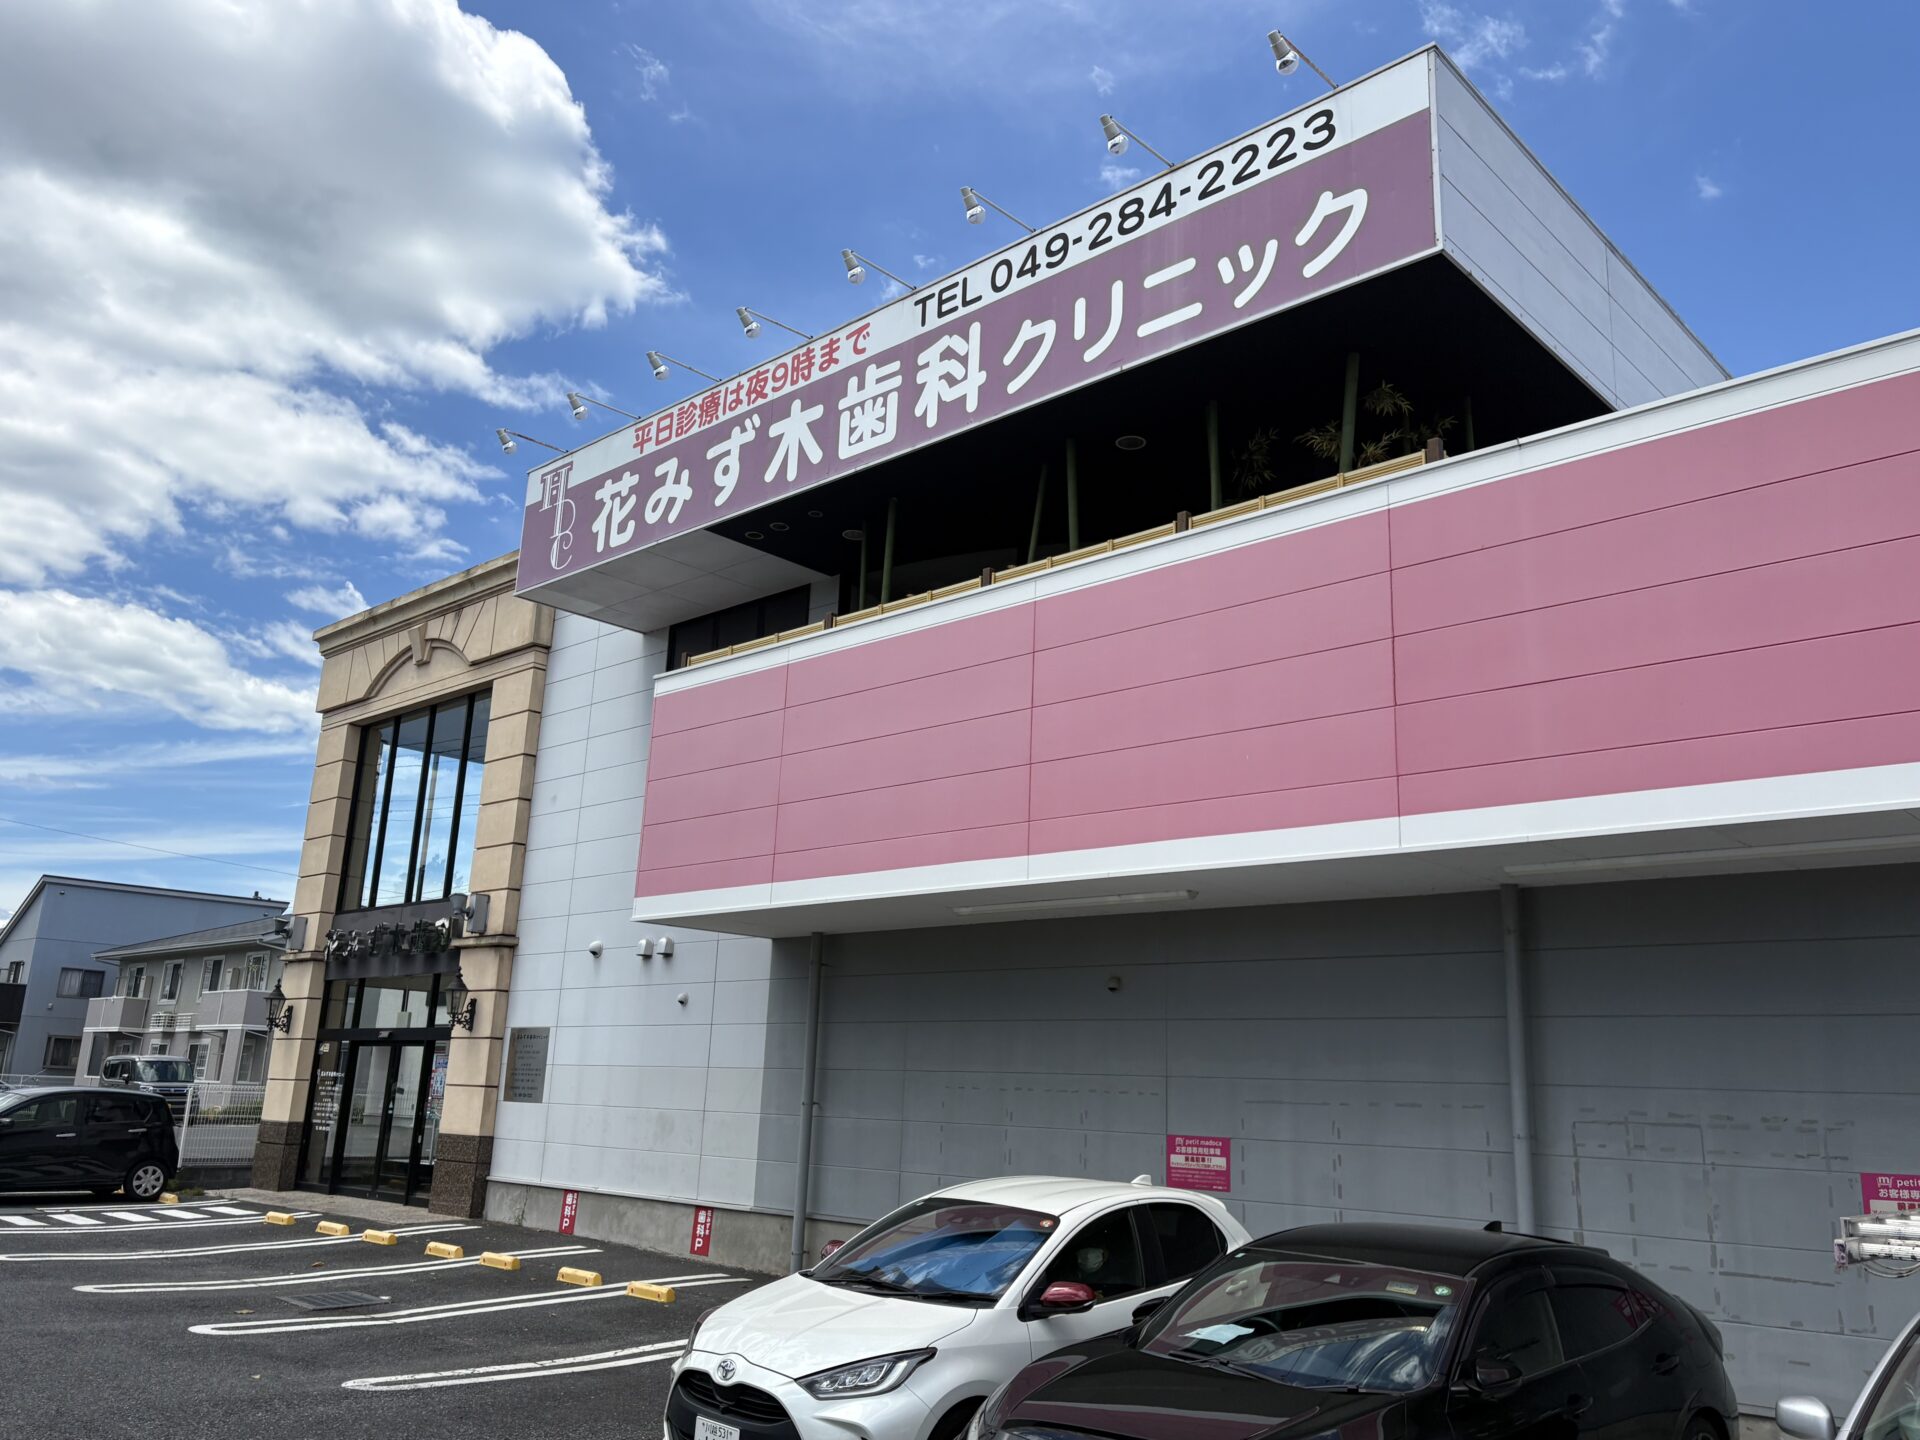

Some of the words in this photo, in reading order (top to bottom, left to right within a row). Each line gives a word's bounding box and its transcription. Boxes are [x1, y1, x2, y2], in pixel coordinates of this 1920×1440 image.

[914, 276, 982, 327] TEL
[991, 108, 1336, 293] 049-284-2223
[591, 187, 1368, 553] 花みず木歯科クリニック
[633, 322, 871, 454] 平日診療は夜9時まで
[1185, 1138, 1200, 1146] petit
